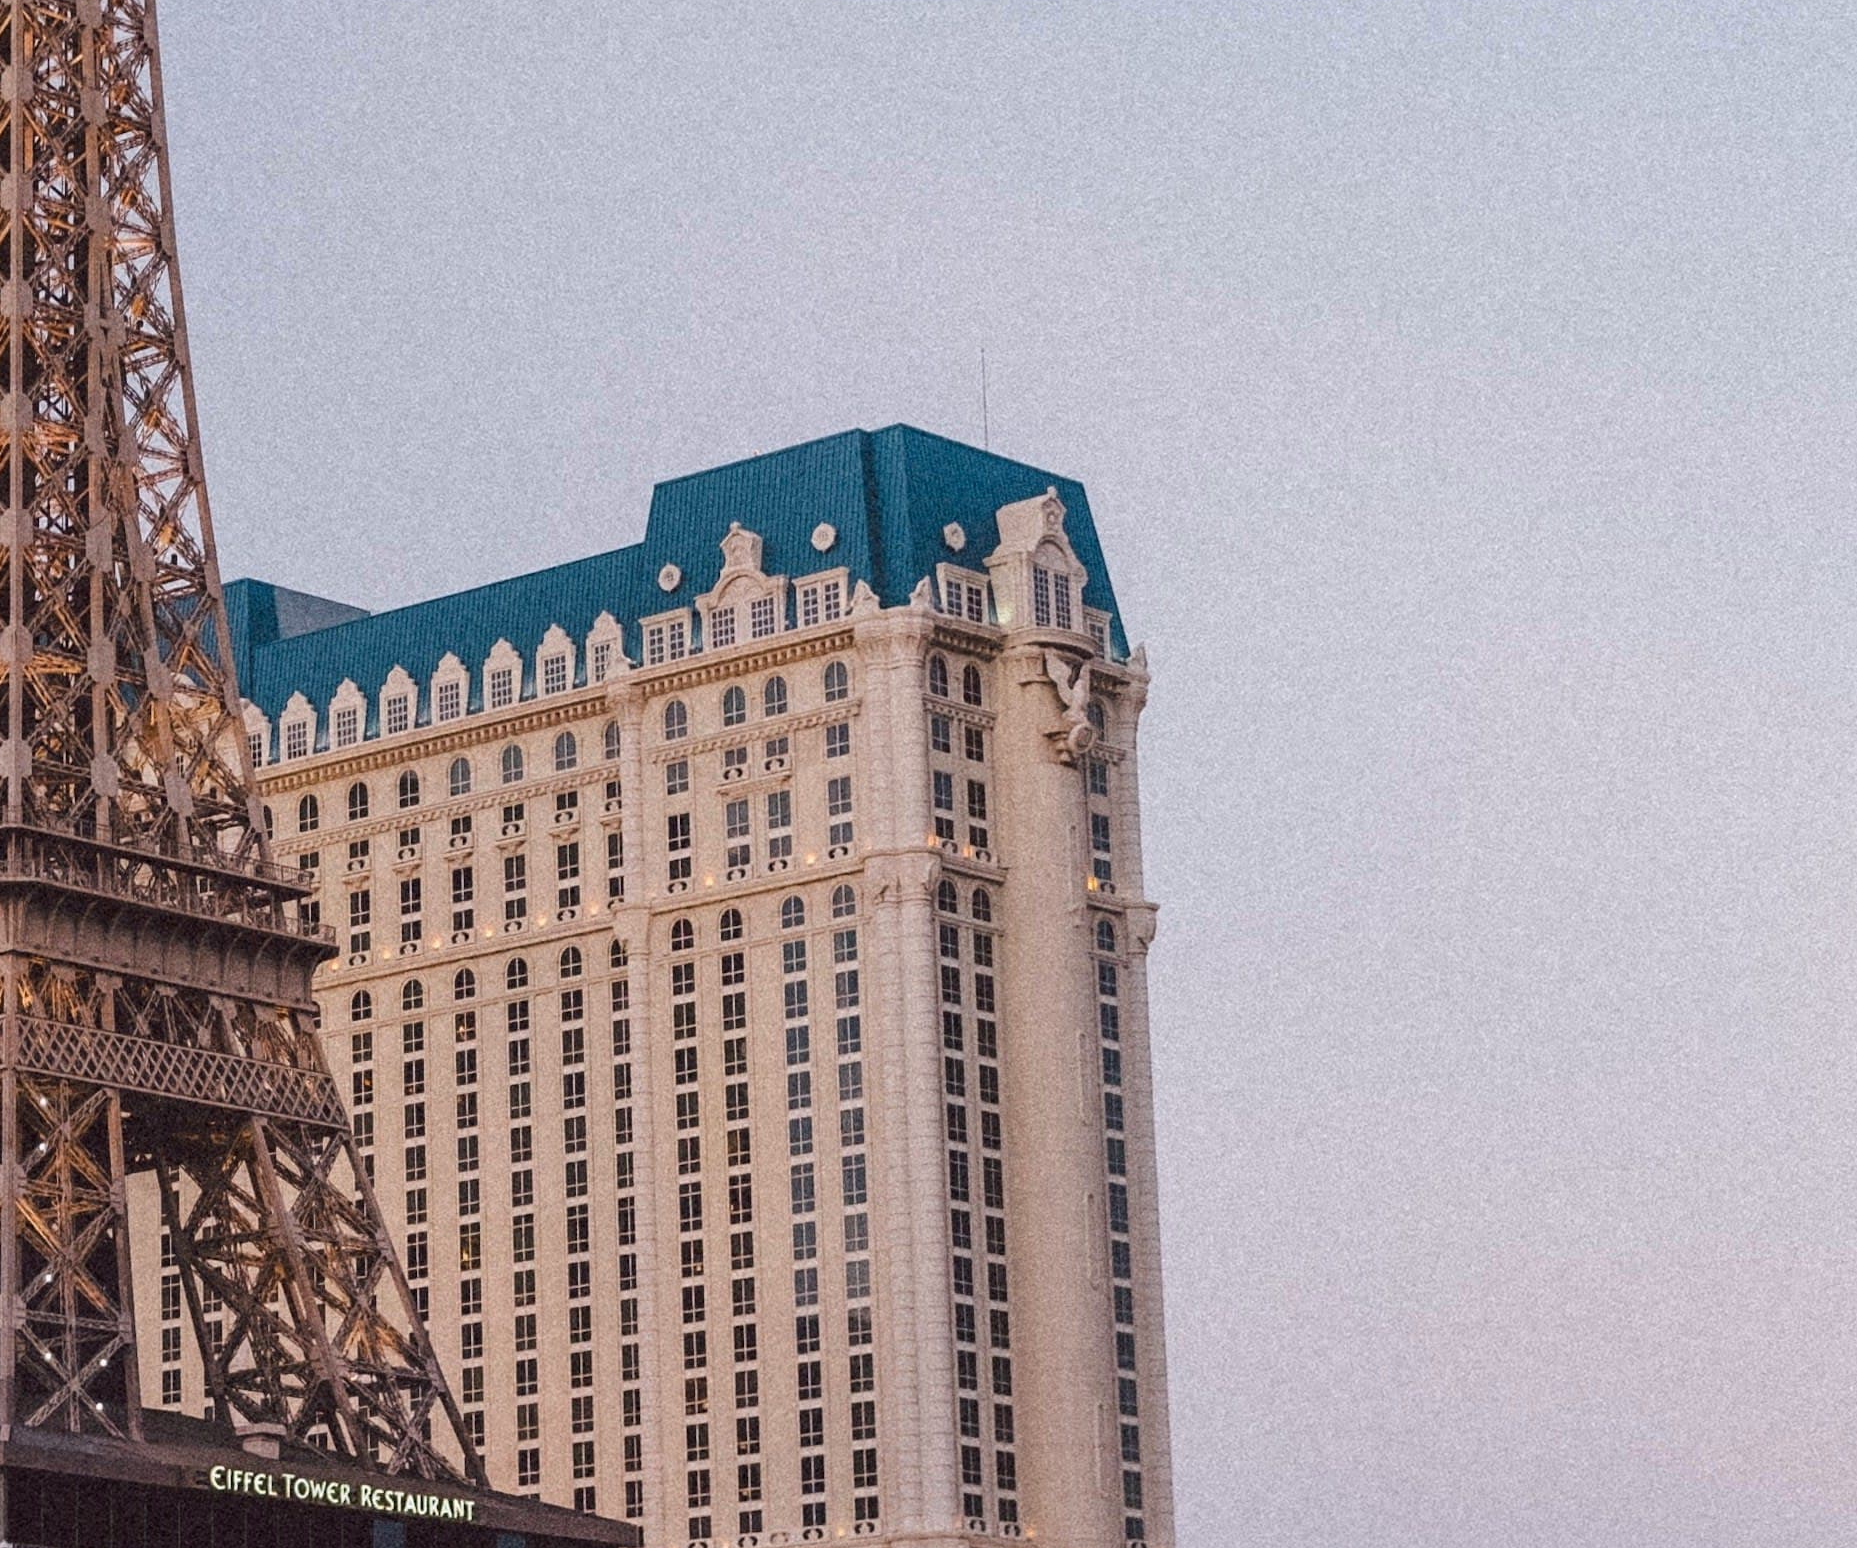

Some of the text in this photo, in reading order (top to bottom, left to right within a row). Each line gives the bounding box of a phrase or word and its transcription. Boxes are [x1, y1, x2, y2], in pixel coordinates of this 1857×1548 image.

[210, 1466, 475, 1521] EIFFEL TOWER RESTAURANT
